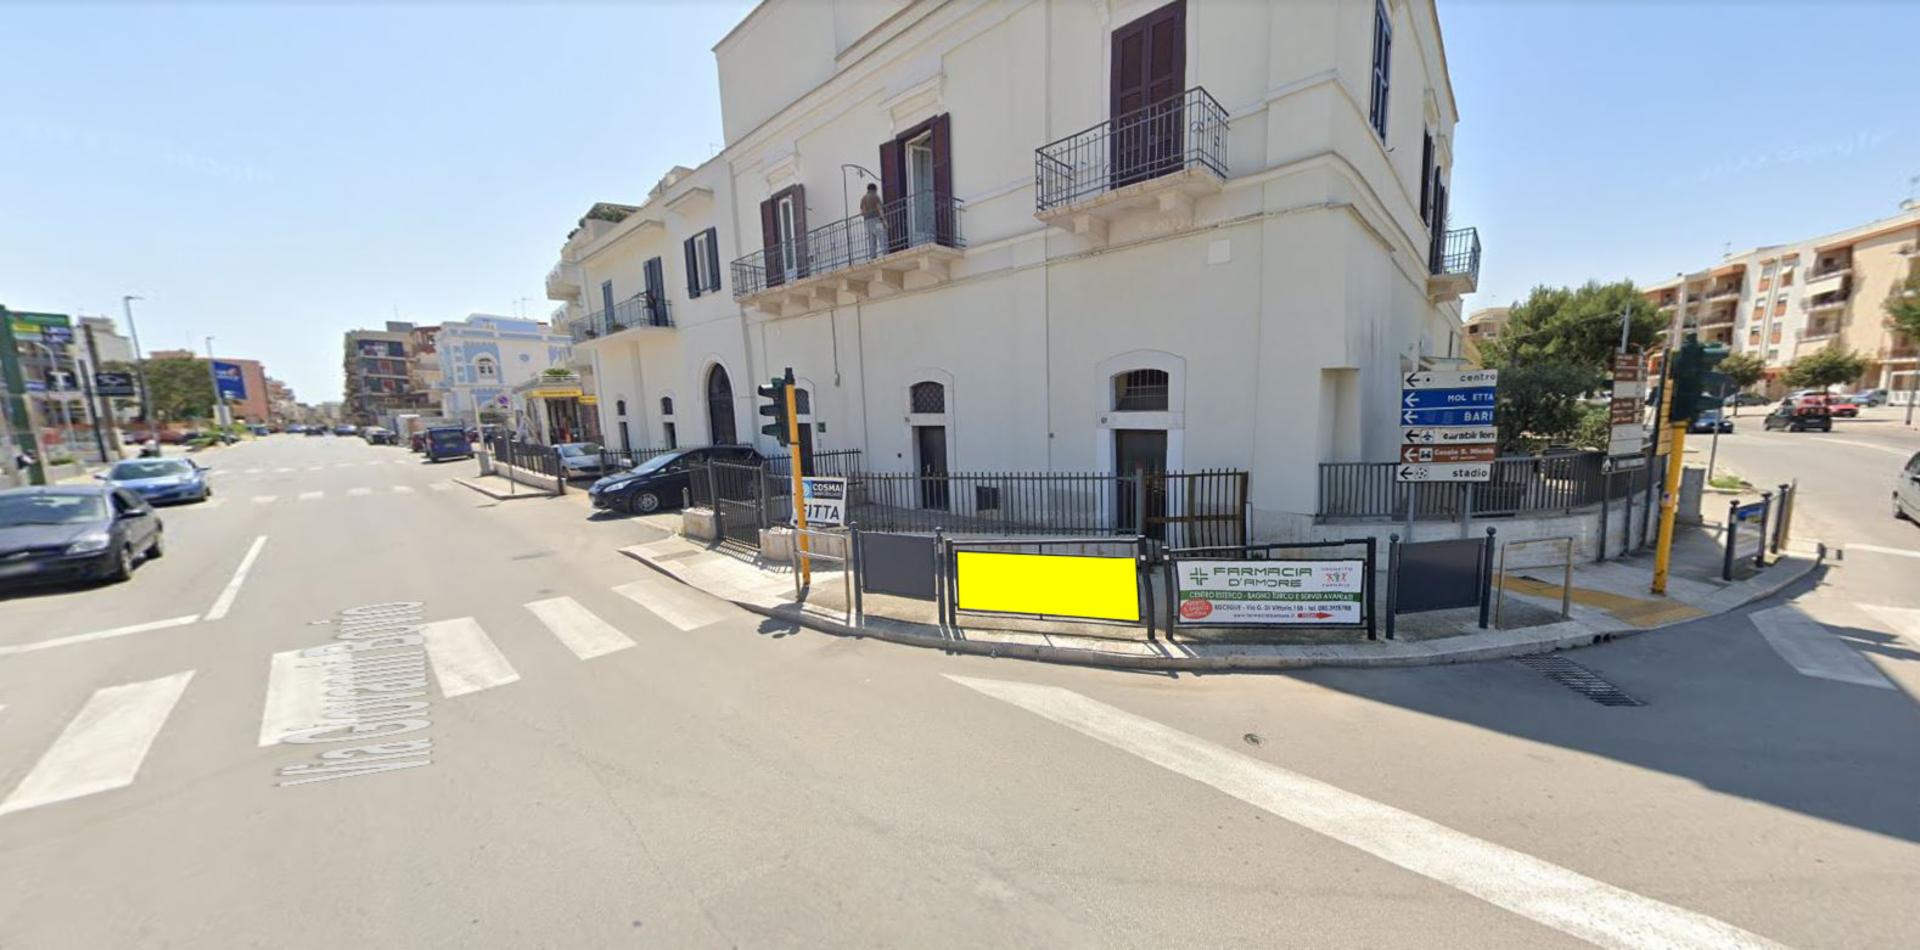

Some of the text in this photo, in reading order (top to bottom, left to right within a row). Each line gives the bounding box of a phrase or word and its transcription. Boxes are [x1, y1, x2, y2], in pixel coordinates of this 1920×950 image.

[1460, 373, 1496, 382] centro
[1464, 411, 1493, 422] BARI
[1452, 468, 1488, 478] stadio
[812, 483, 843, 492] COSMAI
[1213, 567, 1312, 577] FARMACIA
[1228, 577, 1302, 588] D'AMORE
